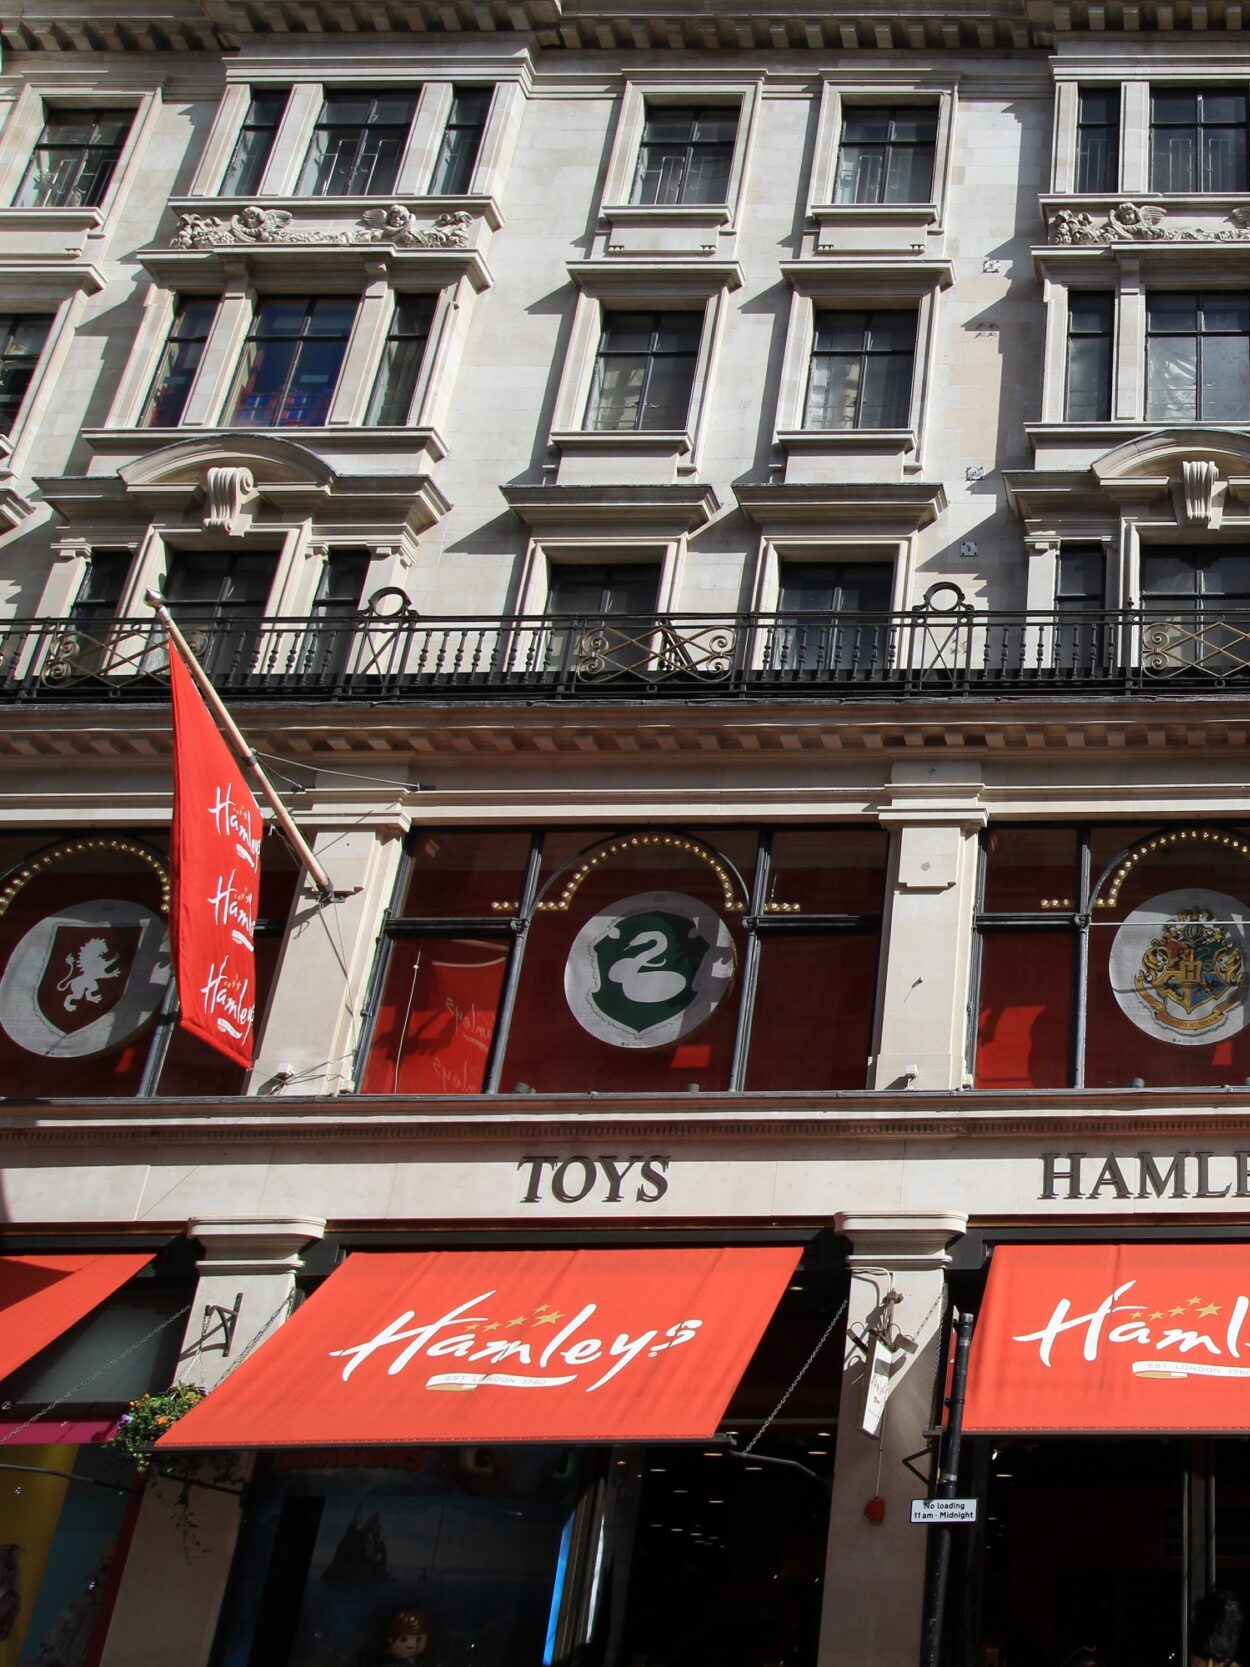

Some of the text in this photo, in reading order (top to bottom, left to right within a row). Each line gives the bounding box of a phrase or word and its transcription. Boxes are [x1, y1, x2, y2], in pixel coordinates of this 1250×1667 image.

[517, 1155, 671, 1204] TOYS
[329, 1289, 703, 1392] Hamleys
[1175, 1364, 1221, 1374] LONDON
[923, 1502, 965, 1510] No loading
[940, 1511, 974, 1519] Midnight
